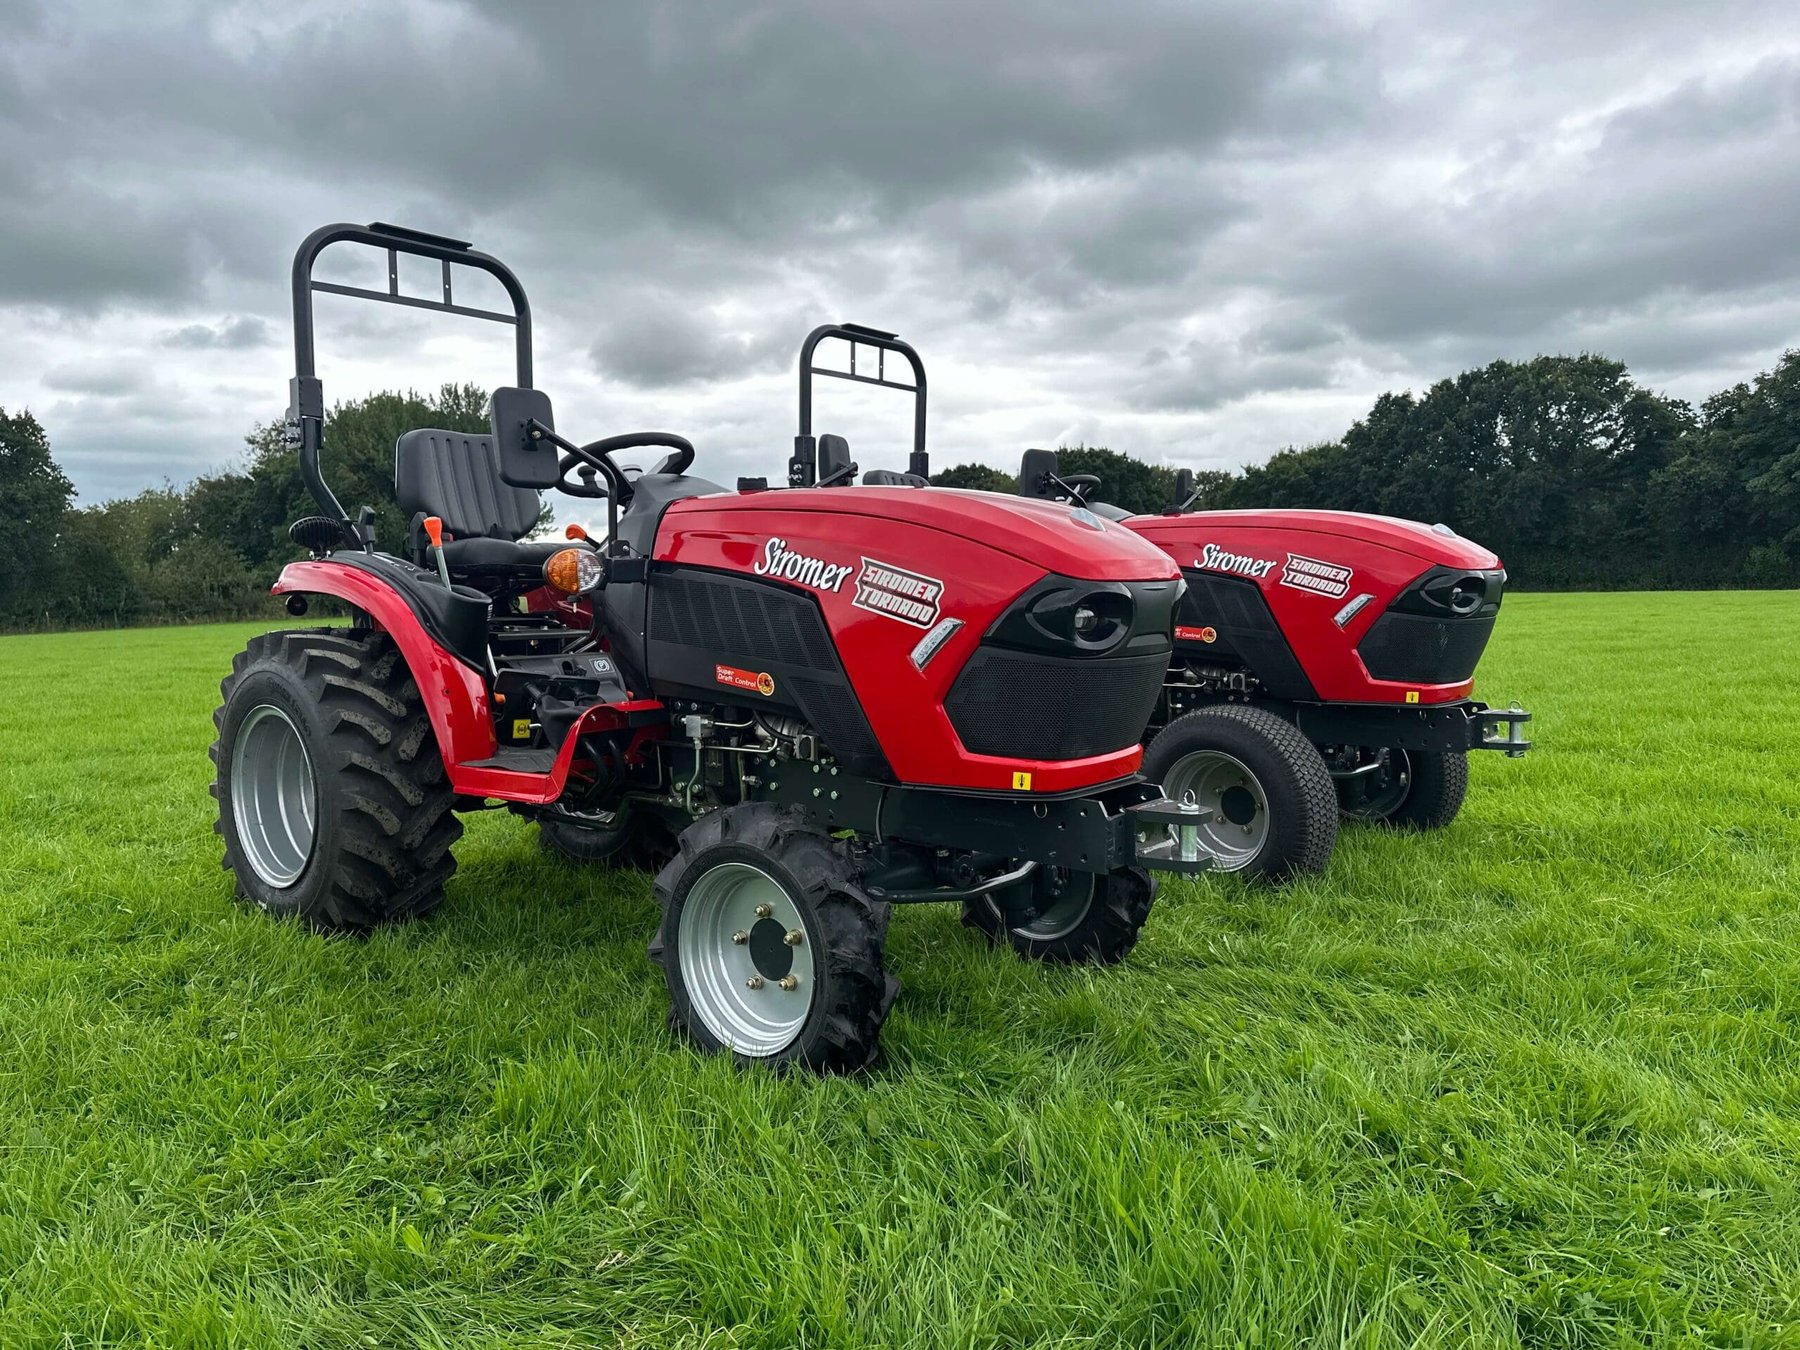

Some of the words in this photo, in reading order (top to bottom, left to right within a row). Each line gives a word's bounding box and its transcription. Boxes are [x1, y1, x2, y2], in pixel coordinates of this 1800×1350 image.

[754, 537, 854, 593] Siromer
[1194, 543, 1277, 578] Siromer
[1290, 558, 1349, 582] SIROMER
[863, 566, 938, 601] SIROMER
[1286, 571, 1346, 595] TORNADO
[859, 586, 936, 622] TORNADO
[717, 666, 734, 676] Super
[717, 673, 733, 682] Draft
[735, 677, 757, 688] Control
